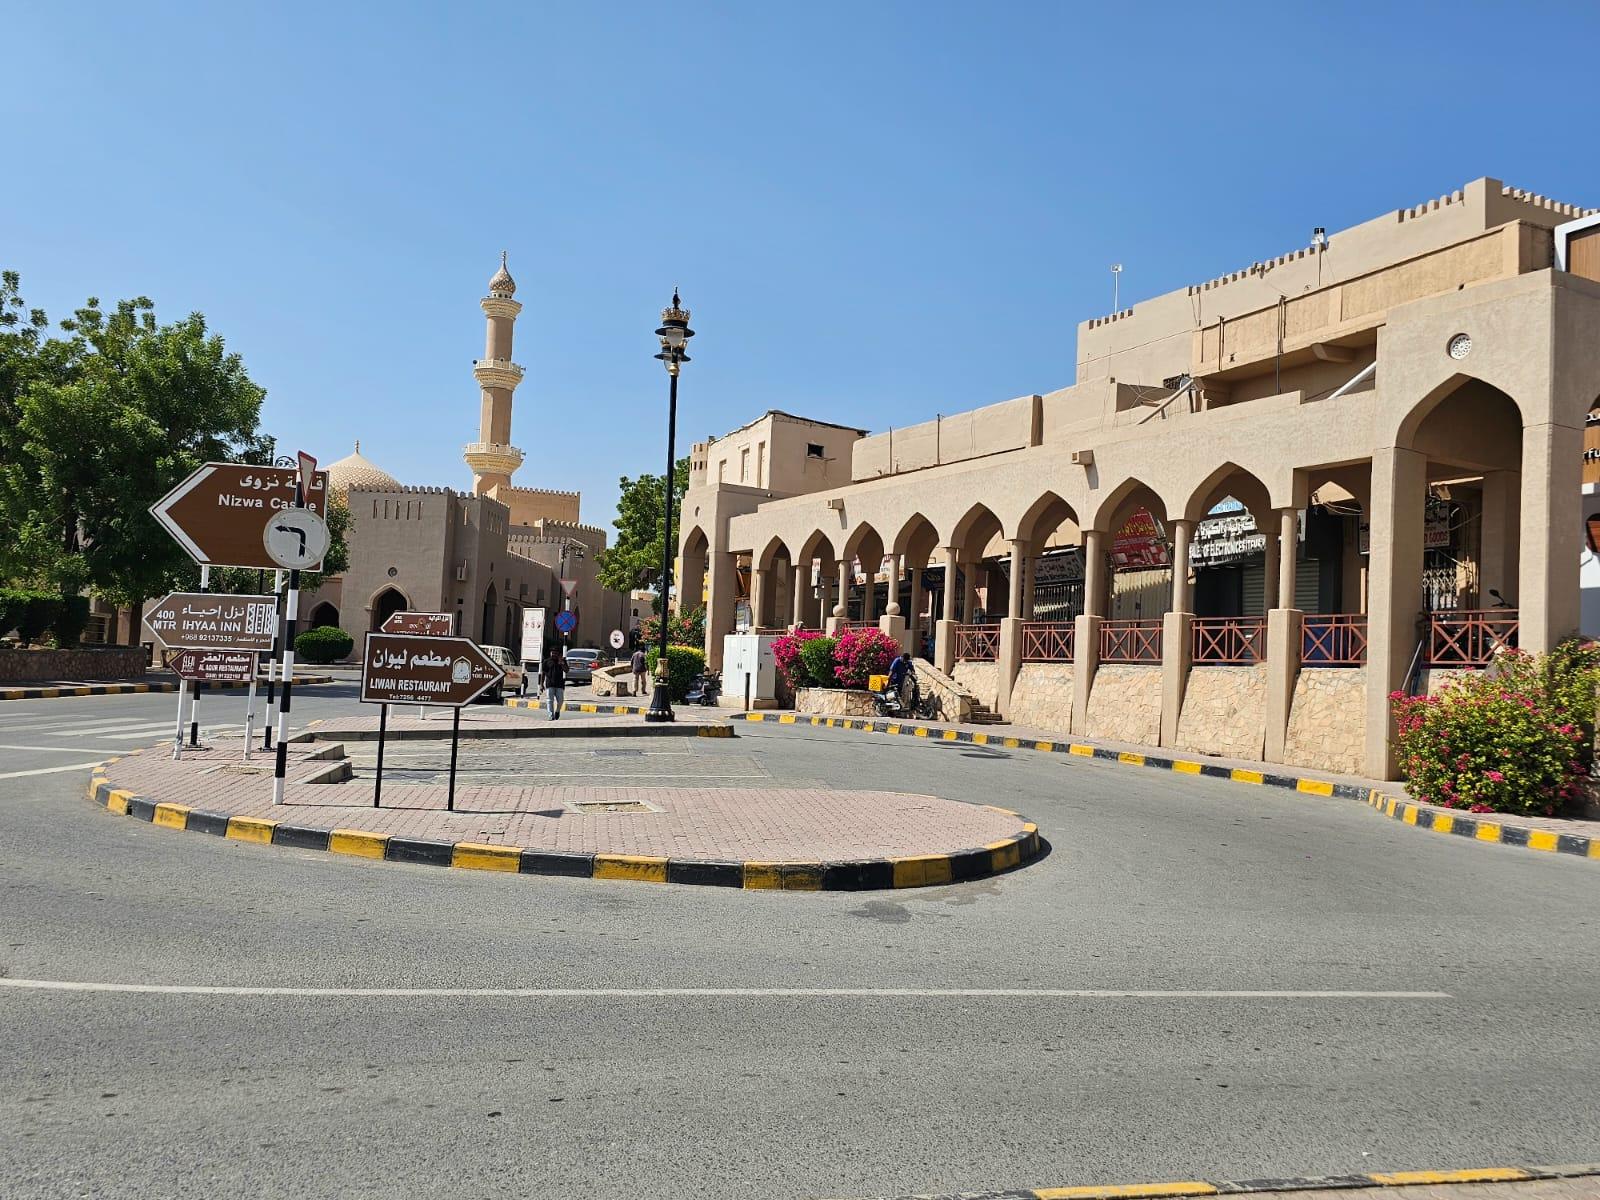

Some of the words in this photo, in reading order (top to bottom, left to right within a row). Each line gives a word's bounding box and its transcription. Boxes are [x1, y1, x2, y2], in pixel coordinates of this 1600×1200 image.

[240, 474, 279, 490] نزوى
[218, 494, 263, 508] Nizwa
[270, 497, 317, 511] Casle
[156, 610, 175, 620] 400
[224, 605, 245, 619] نزل
[153, 620, 176, 630] MTR
[182, 620, 217, 631] IHYAA
[220, 621, 241, 632] INN
[225, 654, 250, 664] مطعم
[372, 648, 408, 669] ليوان
[410, 649, 451, 670] مطعم
[369, 678, 396, 690] LIWAN
[398, 679, 451, 693] RESTAURANT
